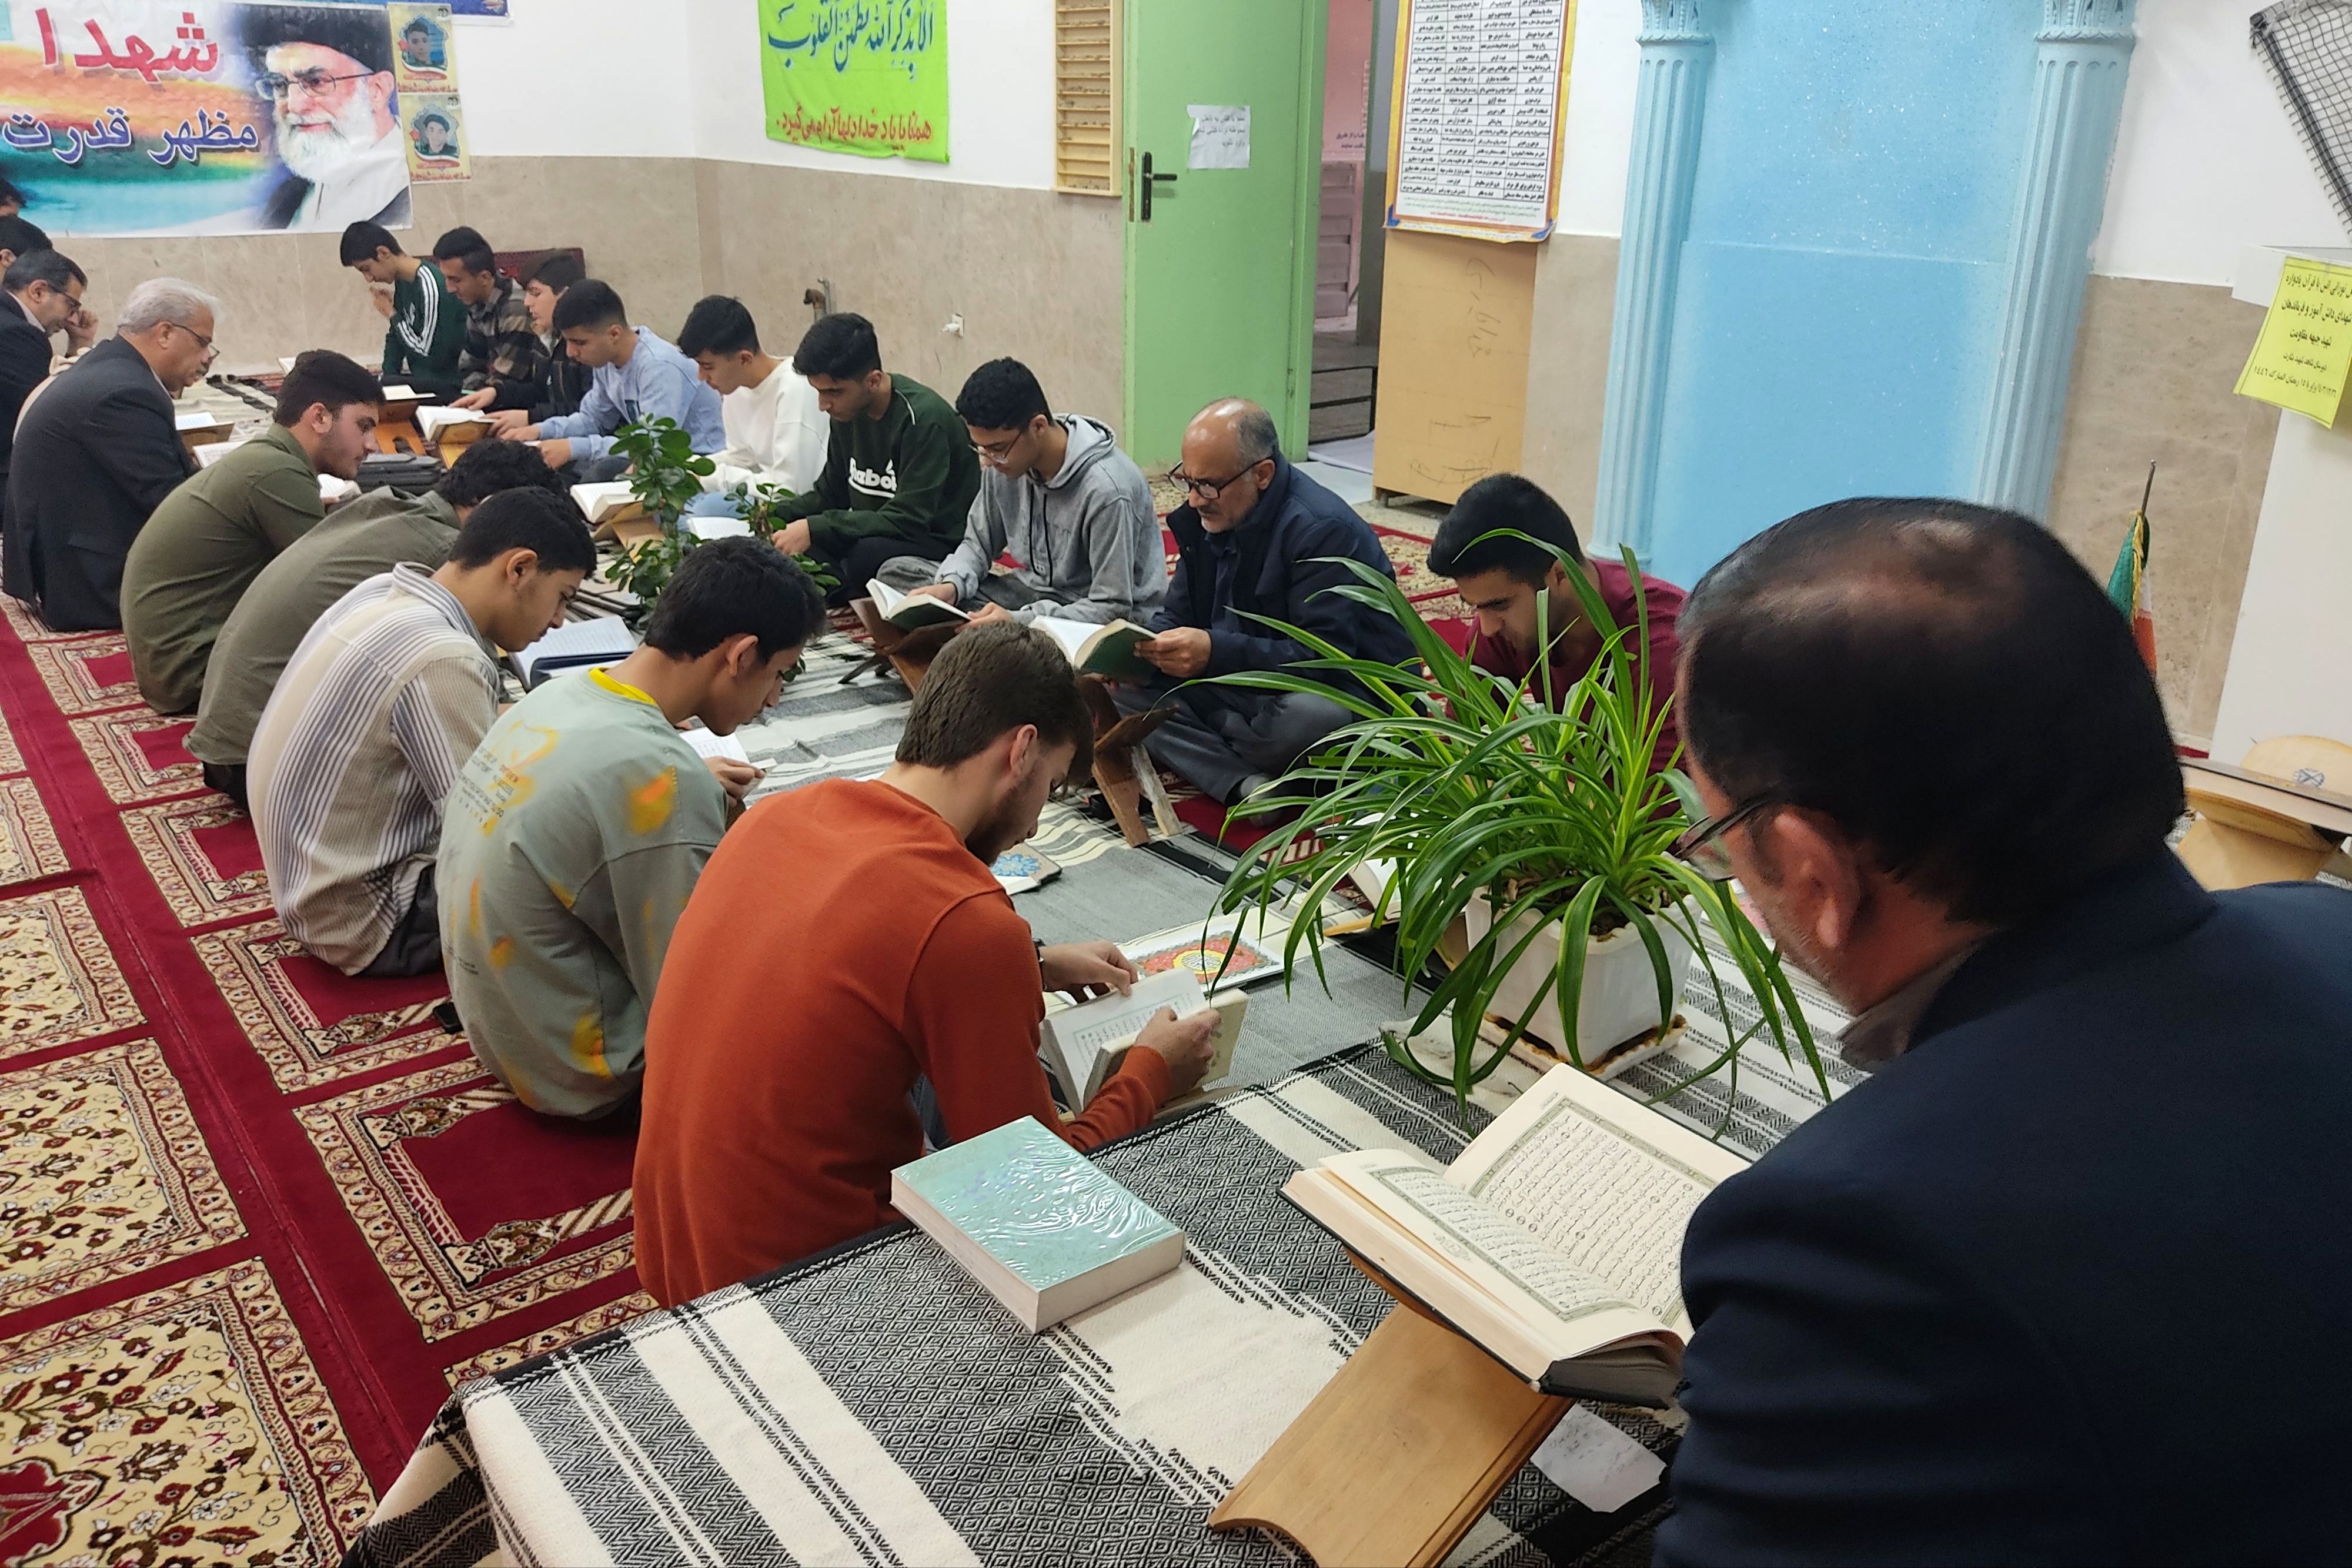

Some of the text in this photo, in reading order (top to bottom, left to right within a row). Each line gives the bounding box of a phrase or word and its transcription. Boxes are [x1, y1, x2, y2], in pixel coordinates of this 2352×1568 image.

[35, 8, 218, 83] شهدا
[2, 108, 259, 165] مظهر قدرت
[2302, 274, 2316, 290] قرآن
[2289, 329, 2308, 342] مقاومت
